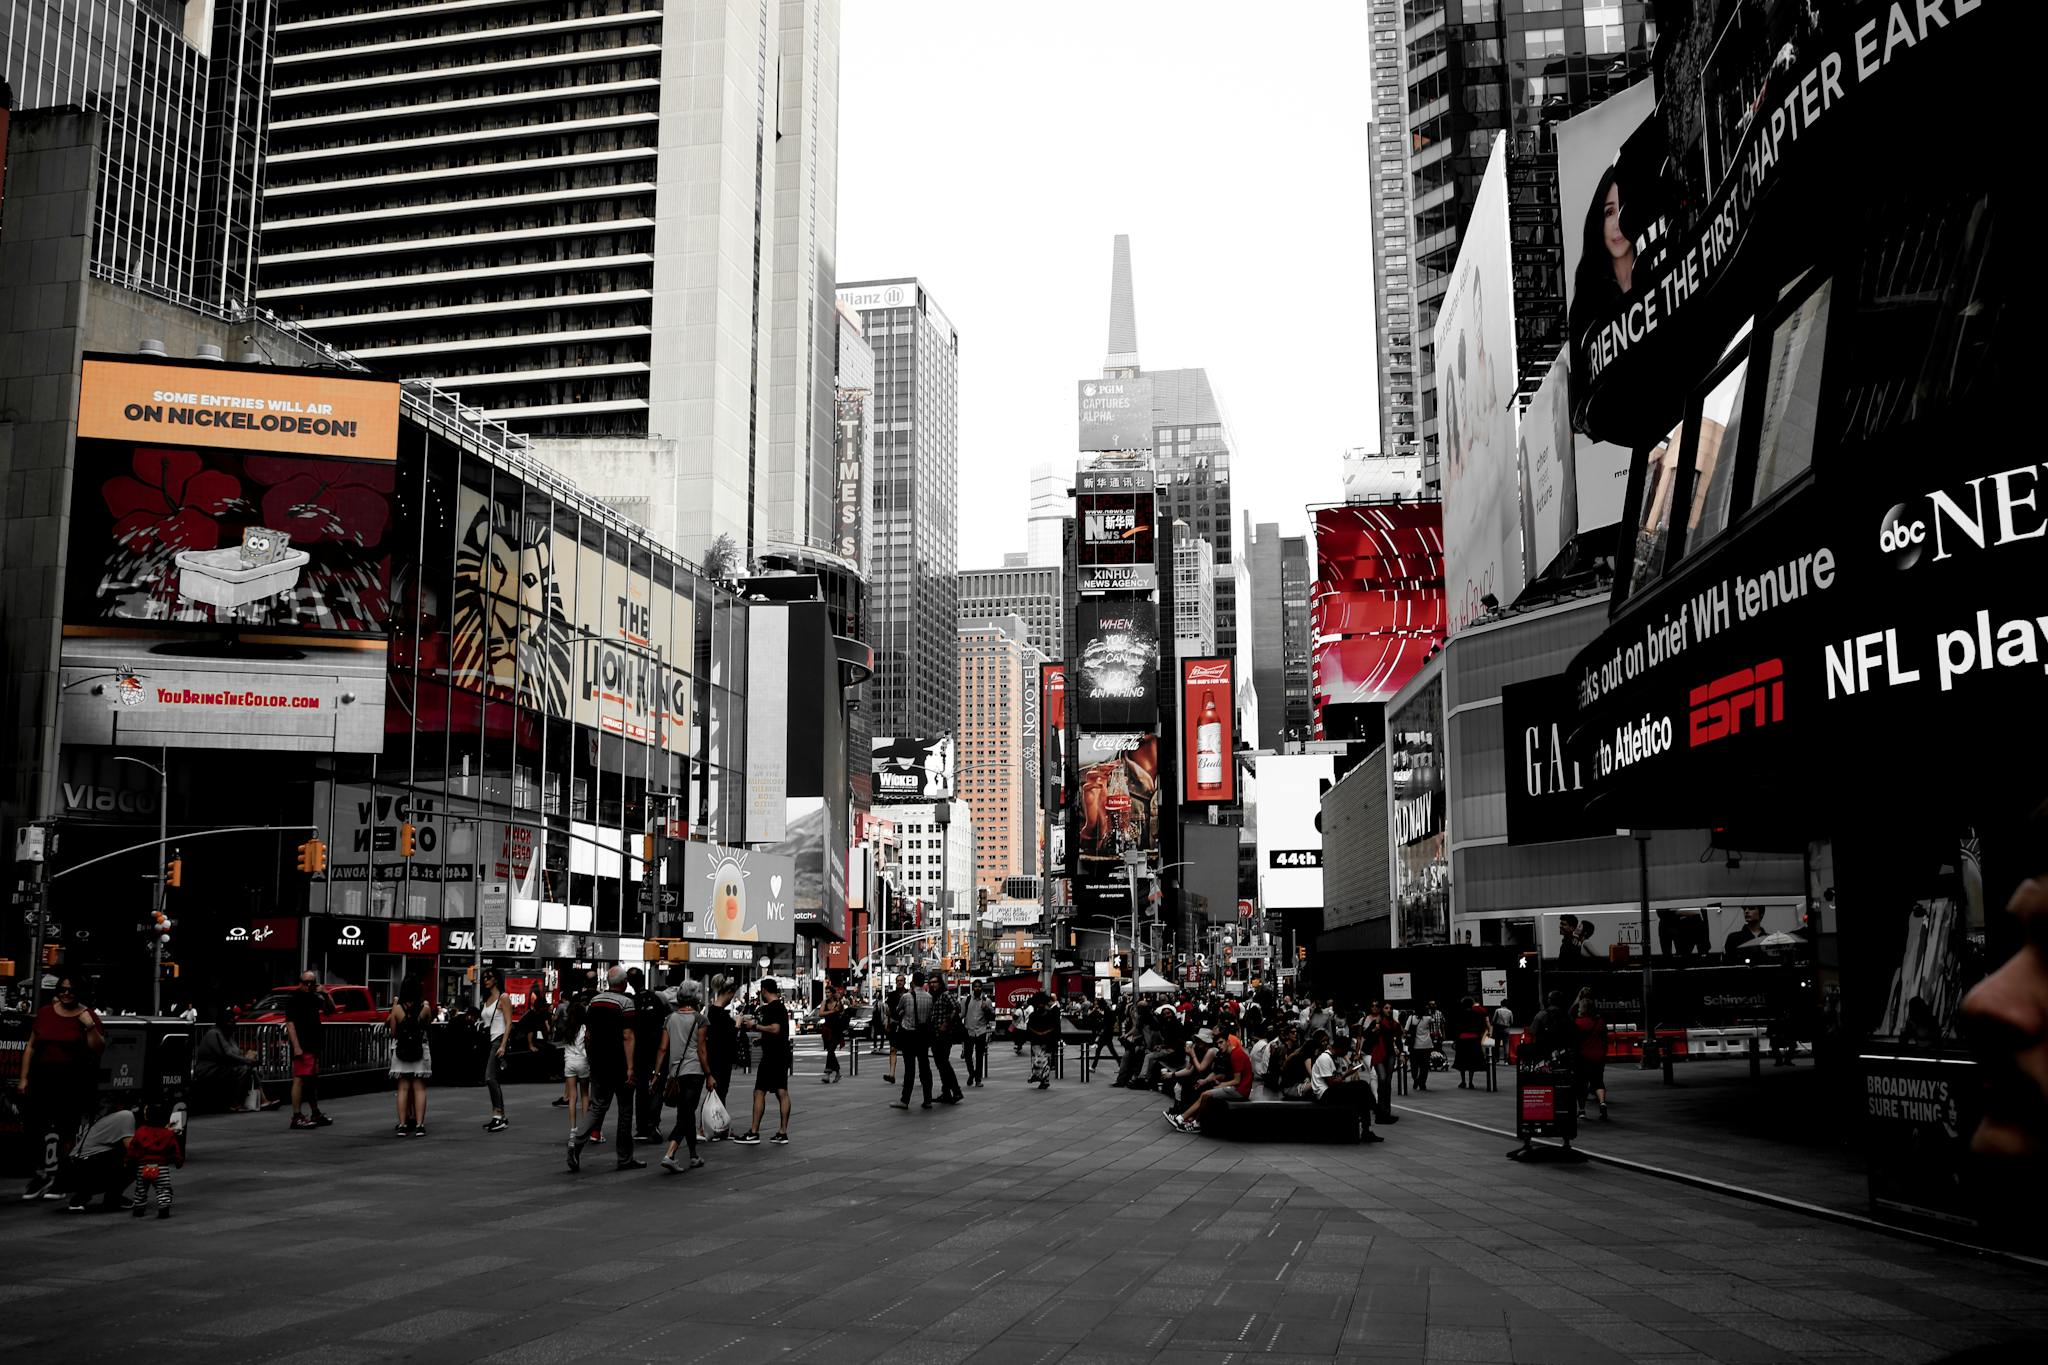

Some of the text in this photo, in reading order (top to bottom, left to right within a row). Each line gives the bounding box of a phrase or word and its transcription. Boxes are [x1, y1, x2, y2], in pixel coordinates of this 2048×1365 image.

[1589, 286, 1659, 382] RIENCE
[1660, 246, 1701, 319] THE
[1700, 184, 1741, 289] FIRST
[1741, 51, 1846, 213] CHAPTER
[838, 287, 881, 306] llianz
[1099, 385, 1124, 394] PGIM
[153, 391, 333, 416] SOME ENTRIES WILL AIR
[1083, 398, 1130, 409] CAPTURES
[124, 403, 358, 439] ON NICKELODEON!
[840, 420, 860, 524] TIMES
[1083, 477, 1146, 489] 新华通讯社
[1880, 462, 2048, 562] abc NE
[1105, 515, 1136, 530] 新华网
[1084, 579, 1149, 588] NEWS AGENCY
[1094, 570, 1139, 580] XINHUA
[617, 596, 649, 638] THE
[1099, 618, 1134, 630] WHEN
[1600, 647, 1623, 695] out
[1625, 640, 1645, 681] on
[1648, 604, 1687, 669] brief
[1691, 580, 1730, 644] WH
[1735, 547, 1836, 623] tenure
[1106, 634, 1127, 645] YOU
[1105, 651, 1128, 663] CAN
[1825, 627, 1921, 700] NFL
[583, 624, 685, 718] LION KING
[1022, 665, 1036, 737] NOVOTEL
[1090, 686, 1145, 698] ANYTHING
[1689, 657, 1785, 749] ESPN
[1599, 738, 1612, 777] to
[1615, 712, 1672, 771] Atletico
[879, 773, 919, 787] WICKED
[1394, 790, 1433, 847] OLD NAVY
[1276, 851, 1317, 866] 44th
[767, 901, 786, 921] NYC
[337, 937, 366, 947] OAKLEY
[733, 949, 744, 960] NEW
[113, 1077, 134, 1087] PAPER
[162, 1075, 182, 1086] TRASH
[1866, 1075, 1950, 1103] BROADWAY'S
[1868, 1096, 1900, 1119] SURE
